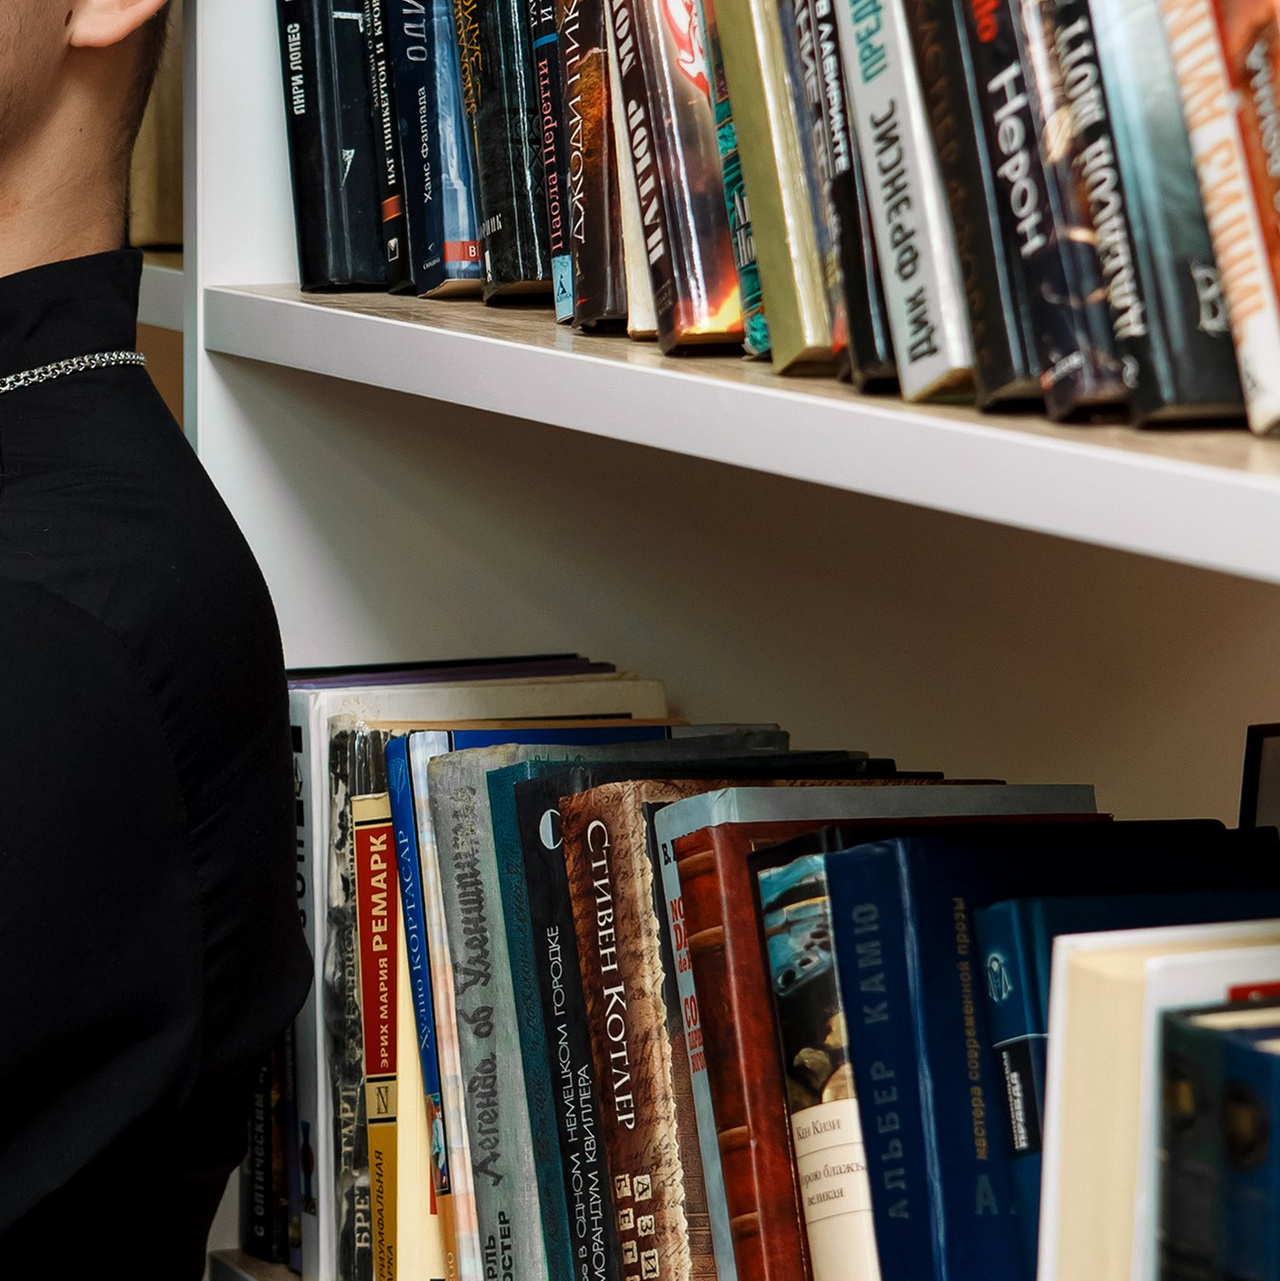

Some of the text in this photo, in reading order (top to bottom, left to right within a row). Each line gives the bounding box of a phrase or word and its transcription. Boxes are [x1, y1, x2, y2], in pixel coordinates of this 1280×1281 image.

[287, 23, 303, 71] ЛОПЕС
[375, 43, 385, 53] И
[541, 7, 554, 21] И
[814, 0, 830, 16] В
[377, 61, 394, 151] ПИНКЕРТОН
[416, 85, 431, 159] Фаллада
[817, 21, 849, 175] ЛАБИРИНТЕ
[386, 158, 397, 186] НАТ
[422, 162, 433, 204] Ханс
[537, 58, 563, 251] Паола Перетти
[567, 95, 585, 244] ДЖОДИ
[627, 99, 664, 264] НАТЮР
[987, 61, 1048, 258] Нерон
[369, 833, 391, 1069] ЭРИХ МАРИЯ РЕМАРК
[399, 830, 430, 1051] Хулио КОРТАСАР
[545, 927, 567, 1016] ГОРОДКЕ
[556, 1024, 578, 1143] НЕМЕЦКОМ
[851, 903, 910, 1219] АЛЬБЕР КАМЮ
[578, 1065, 597, 1164] КВИЛЛЕРА
[812, 1116, 841, 1134] Кизи
[568, 1153, 588, 1239] ОДНОМ
[807, 1186, 844, 1207] великая
[577, 1246, 587, 1258] В
